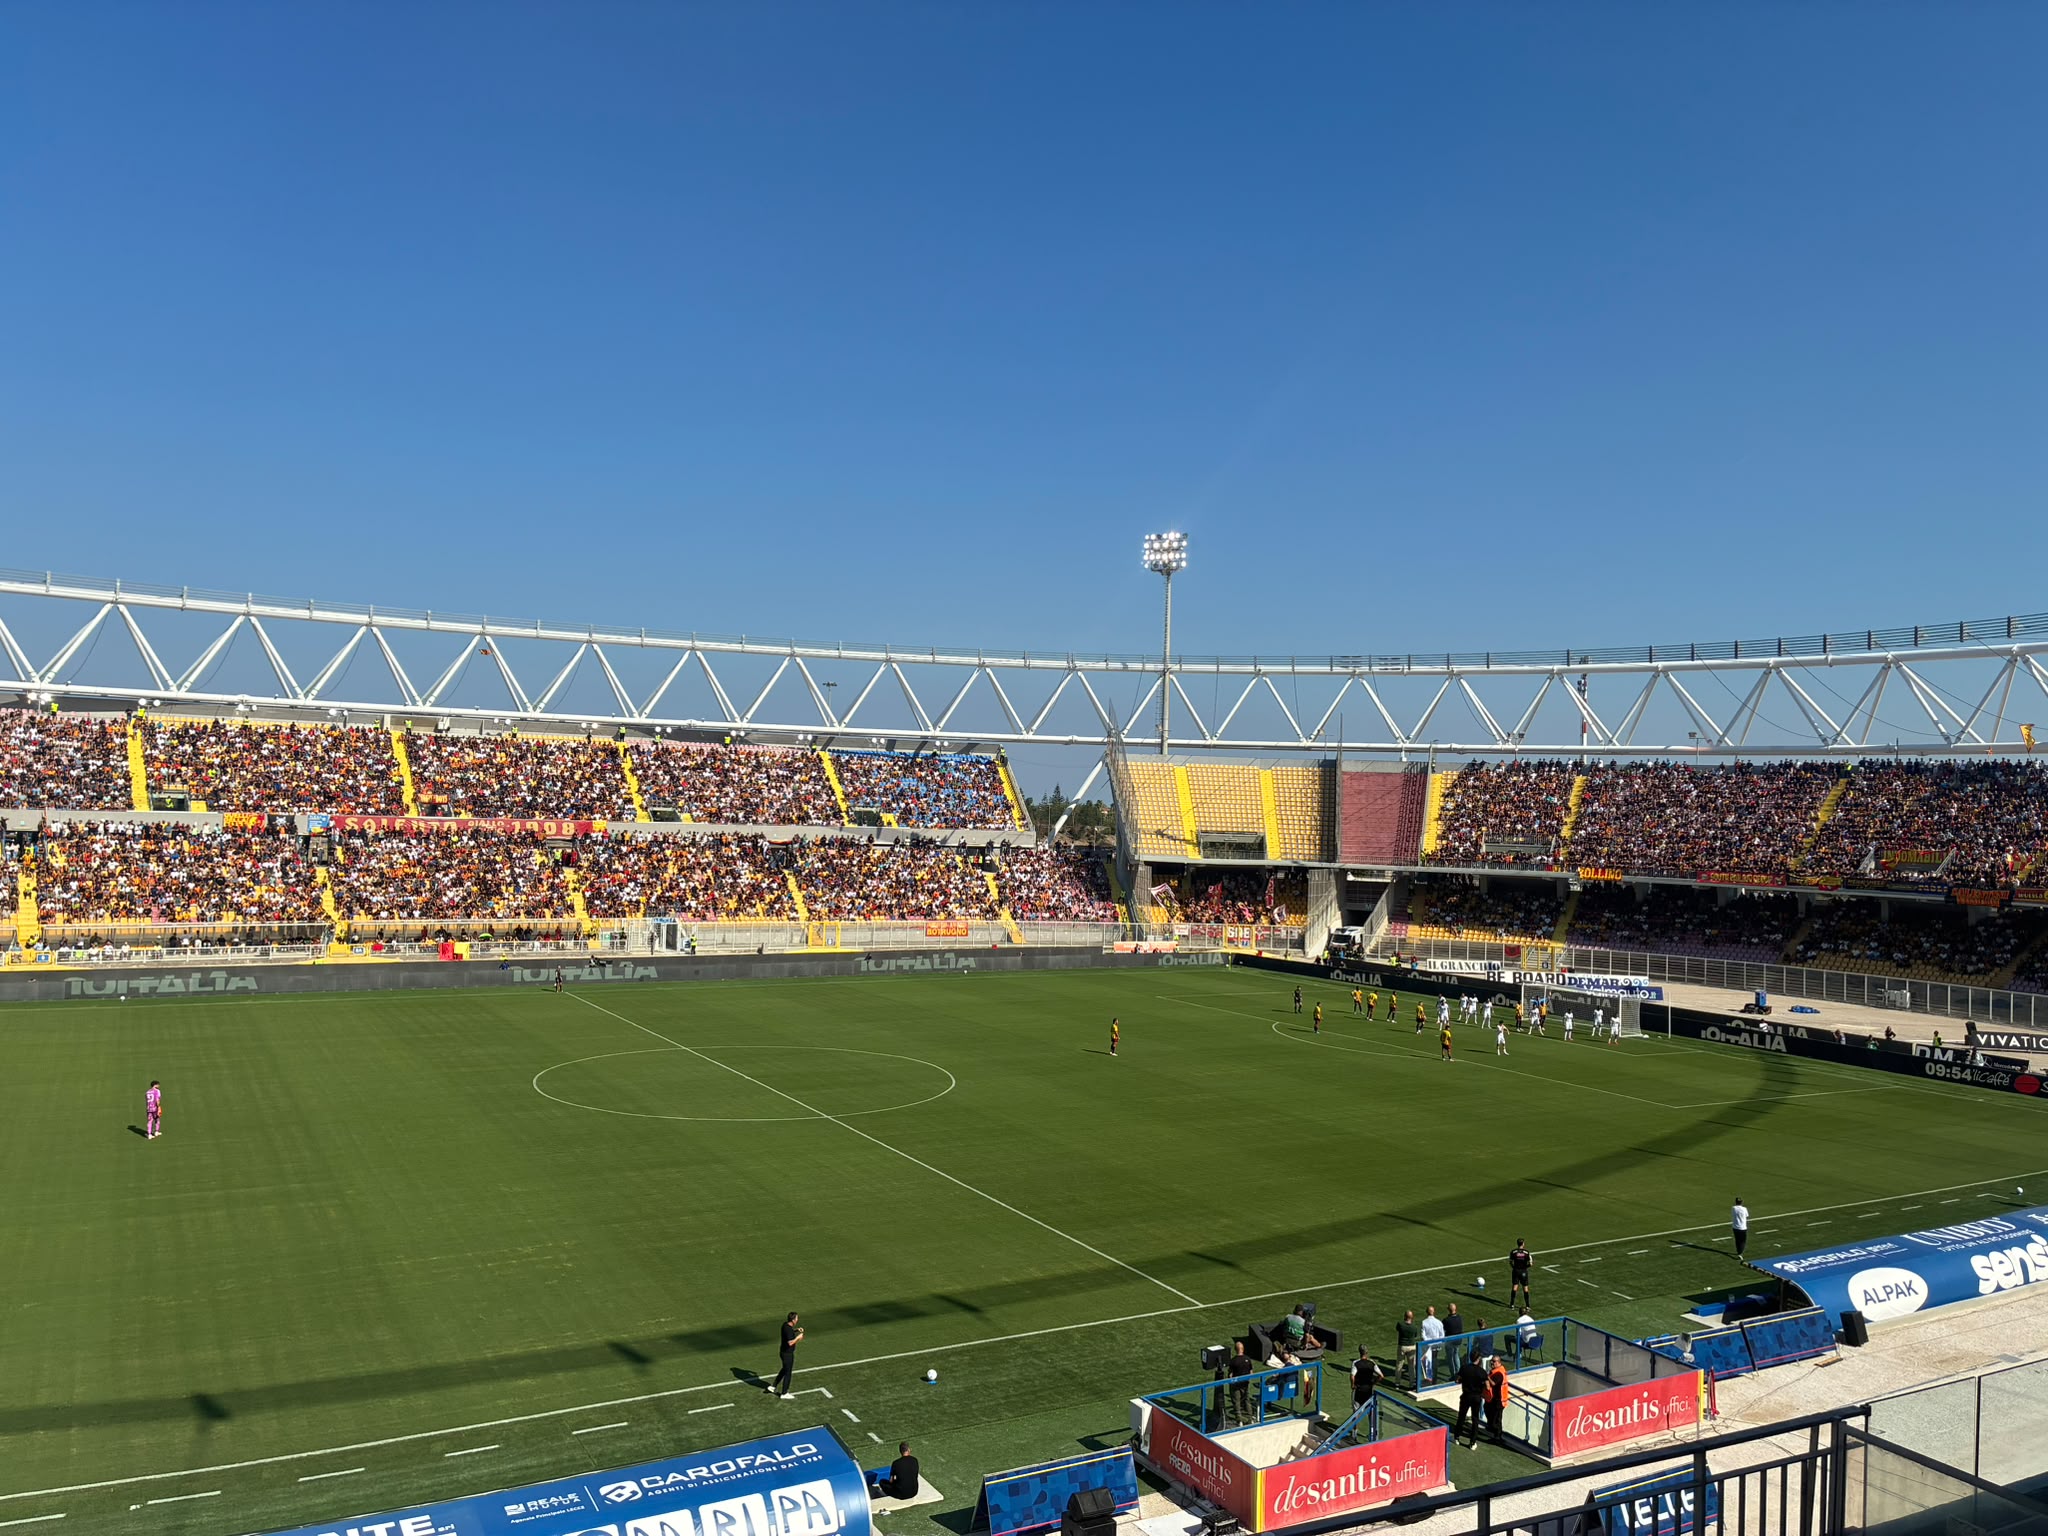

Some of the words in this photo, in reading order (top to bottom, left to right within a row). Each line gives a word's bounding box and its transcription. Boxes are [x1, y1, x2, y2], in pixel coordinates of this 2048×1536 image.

[1487, 971, 1505, 982] BE
[1513, 972, 1567, 985] BOARD
[1925, 1061, 1972, 1081] 09:54
[1863, 1279, 1919, 1306] ALPAK
[1566, 1391, 1660, 1438] desantis
[1662, 1395, 1691, 1416] uffici.
[640, 1443, 818, 1489] CAROFALO
[1170, 1429, 1232, 1486] desantis
[647, 1485, 685, 1497] AGENTI
[701, 1466, 778, 1486] ASSICURAZIONE
[780, 1461, 800, 1470] DAL
[801, 1454, 823, 1465] 1989
[1273, 1455, 1391, 1515] desantis
[1395, 1459, 1431, 1483] uffici.
[526, 1492, 578, 1508] REALE
[529, 1498, 582, 1512] MUTUA
[566, 1505, 586, 1513] LECCE
